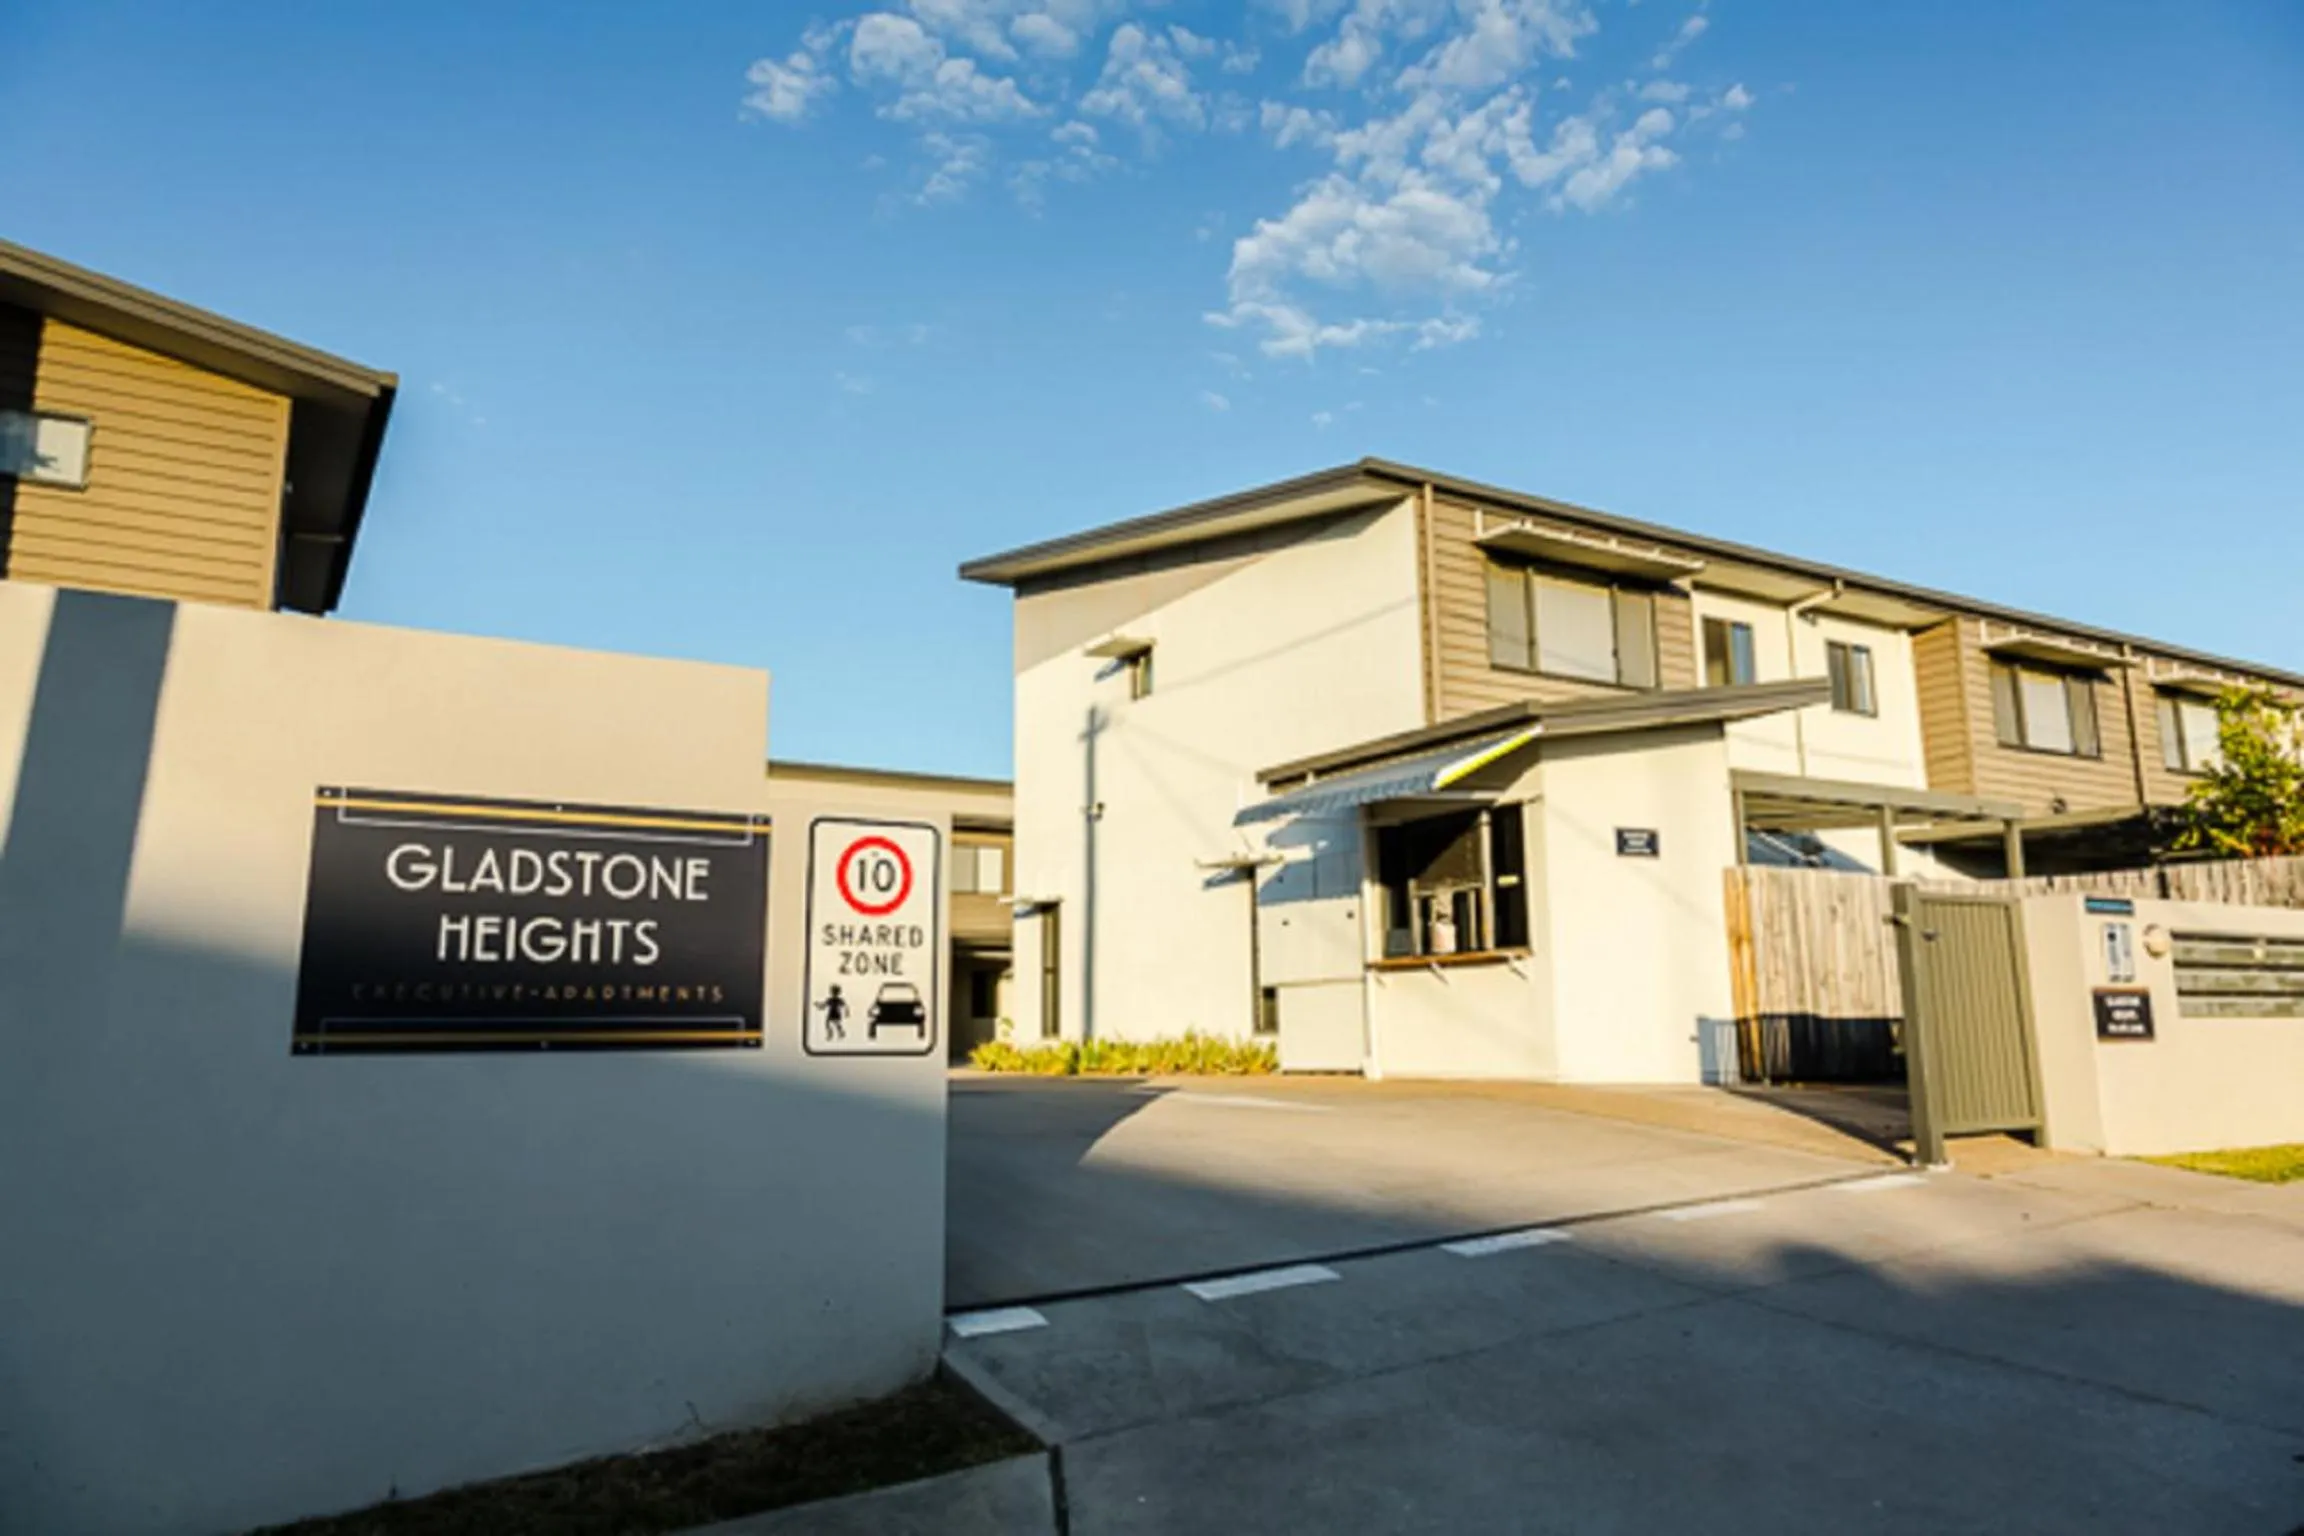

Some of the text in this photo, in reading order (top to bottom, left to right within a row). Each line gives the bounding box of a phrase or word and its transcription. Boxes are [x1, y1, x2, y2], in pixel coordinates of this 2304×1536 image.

[386, 844, 711, 901] GLADSTONE
[858, 857, 897, 893] 10
[437, 914, 660, 965] HEIGHTS
[822, 923, 924, 948] SHARED
[838, 951, 904, 976] ZONE
